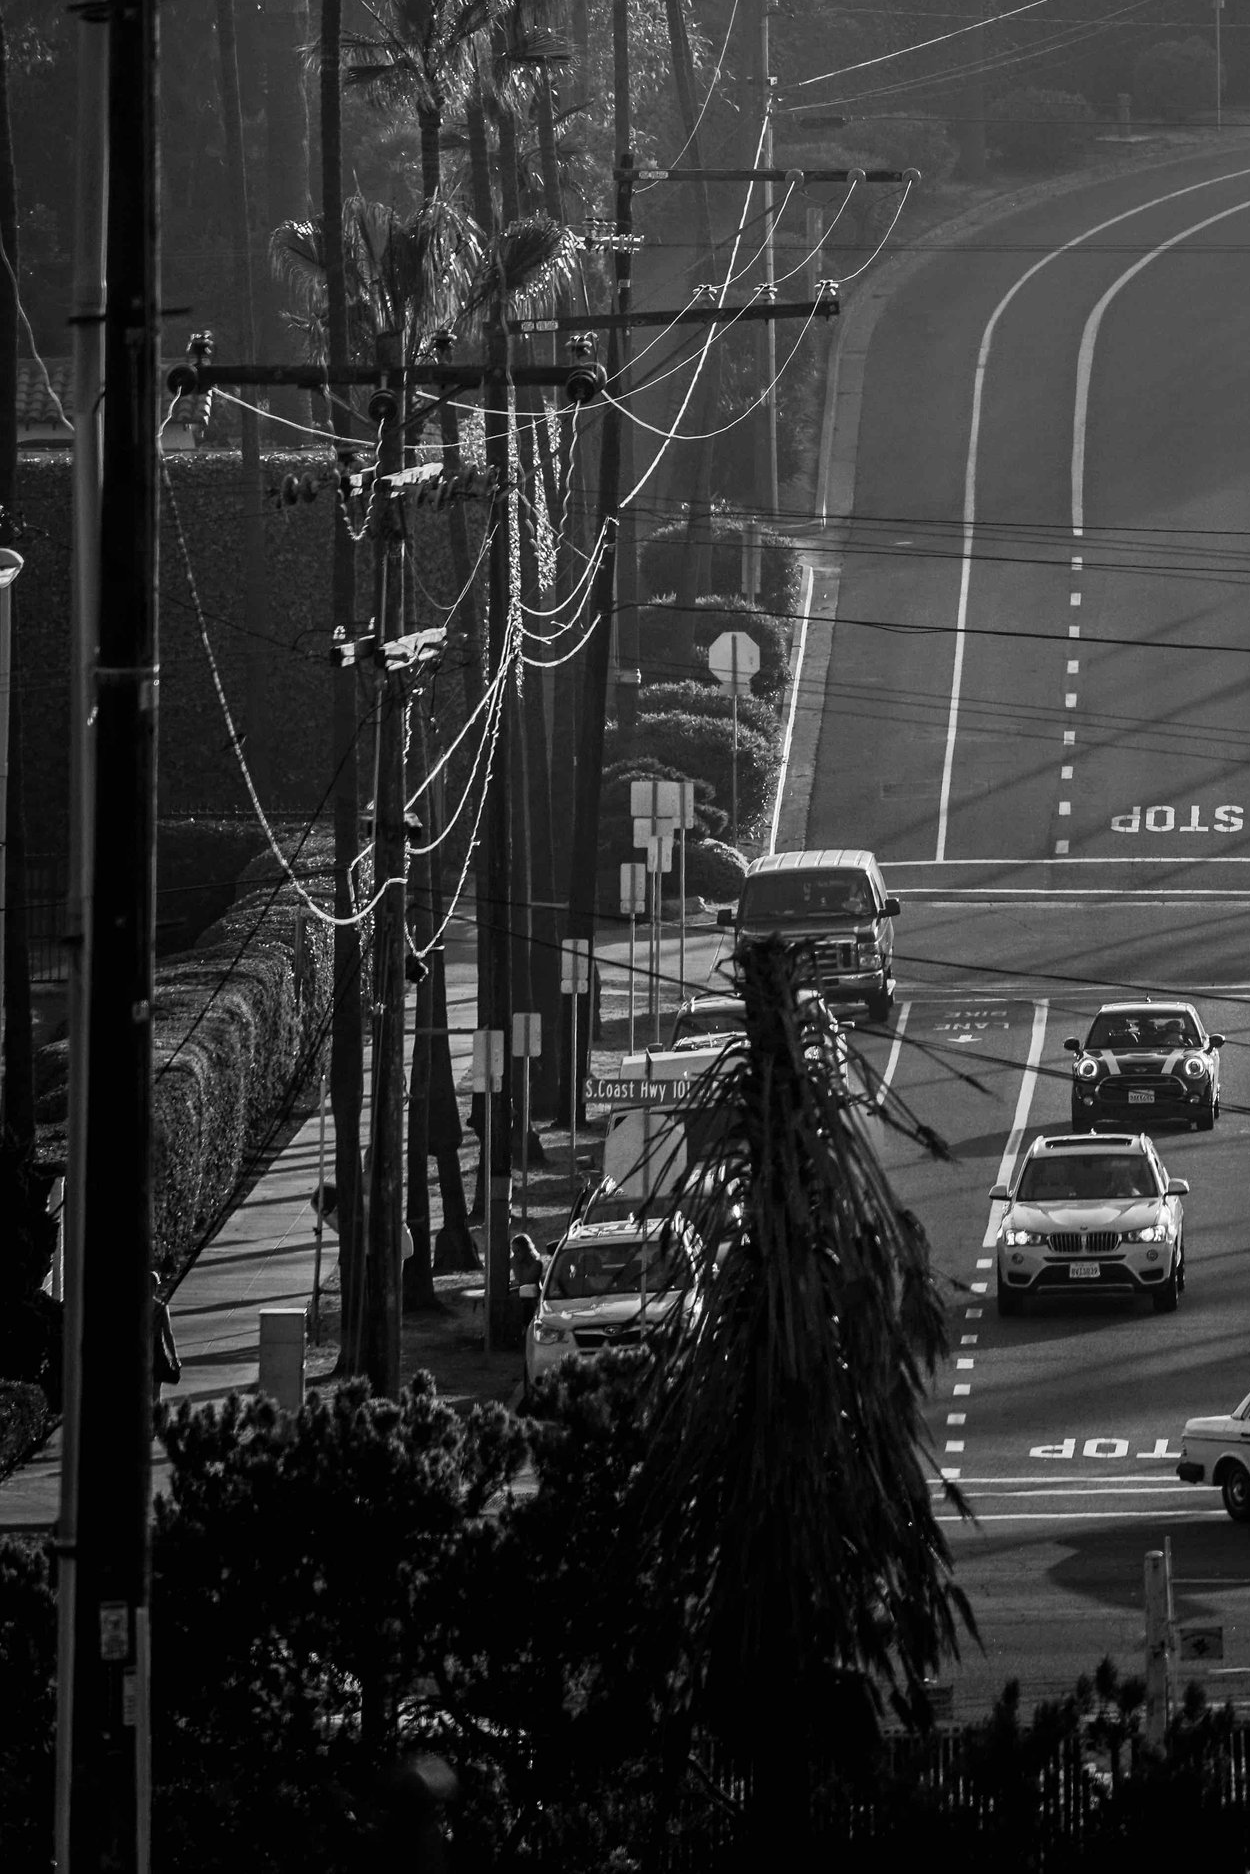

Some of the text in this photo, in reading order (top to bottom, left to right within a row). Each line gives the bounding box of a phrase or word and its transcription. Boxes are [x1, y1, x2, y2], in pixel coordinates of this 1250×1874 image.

[1111, 806, 1243, 832] STOP
[933, 1022, 1010, 1031] LANE
[640, 1080, 667, 1102] Hwy
[1029, 1438, 1182, 1459] TOP
